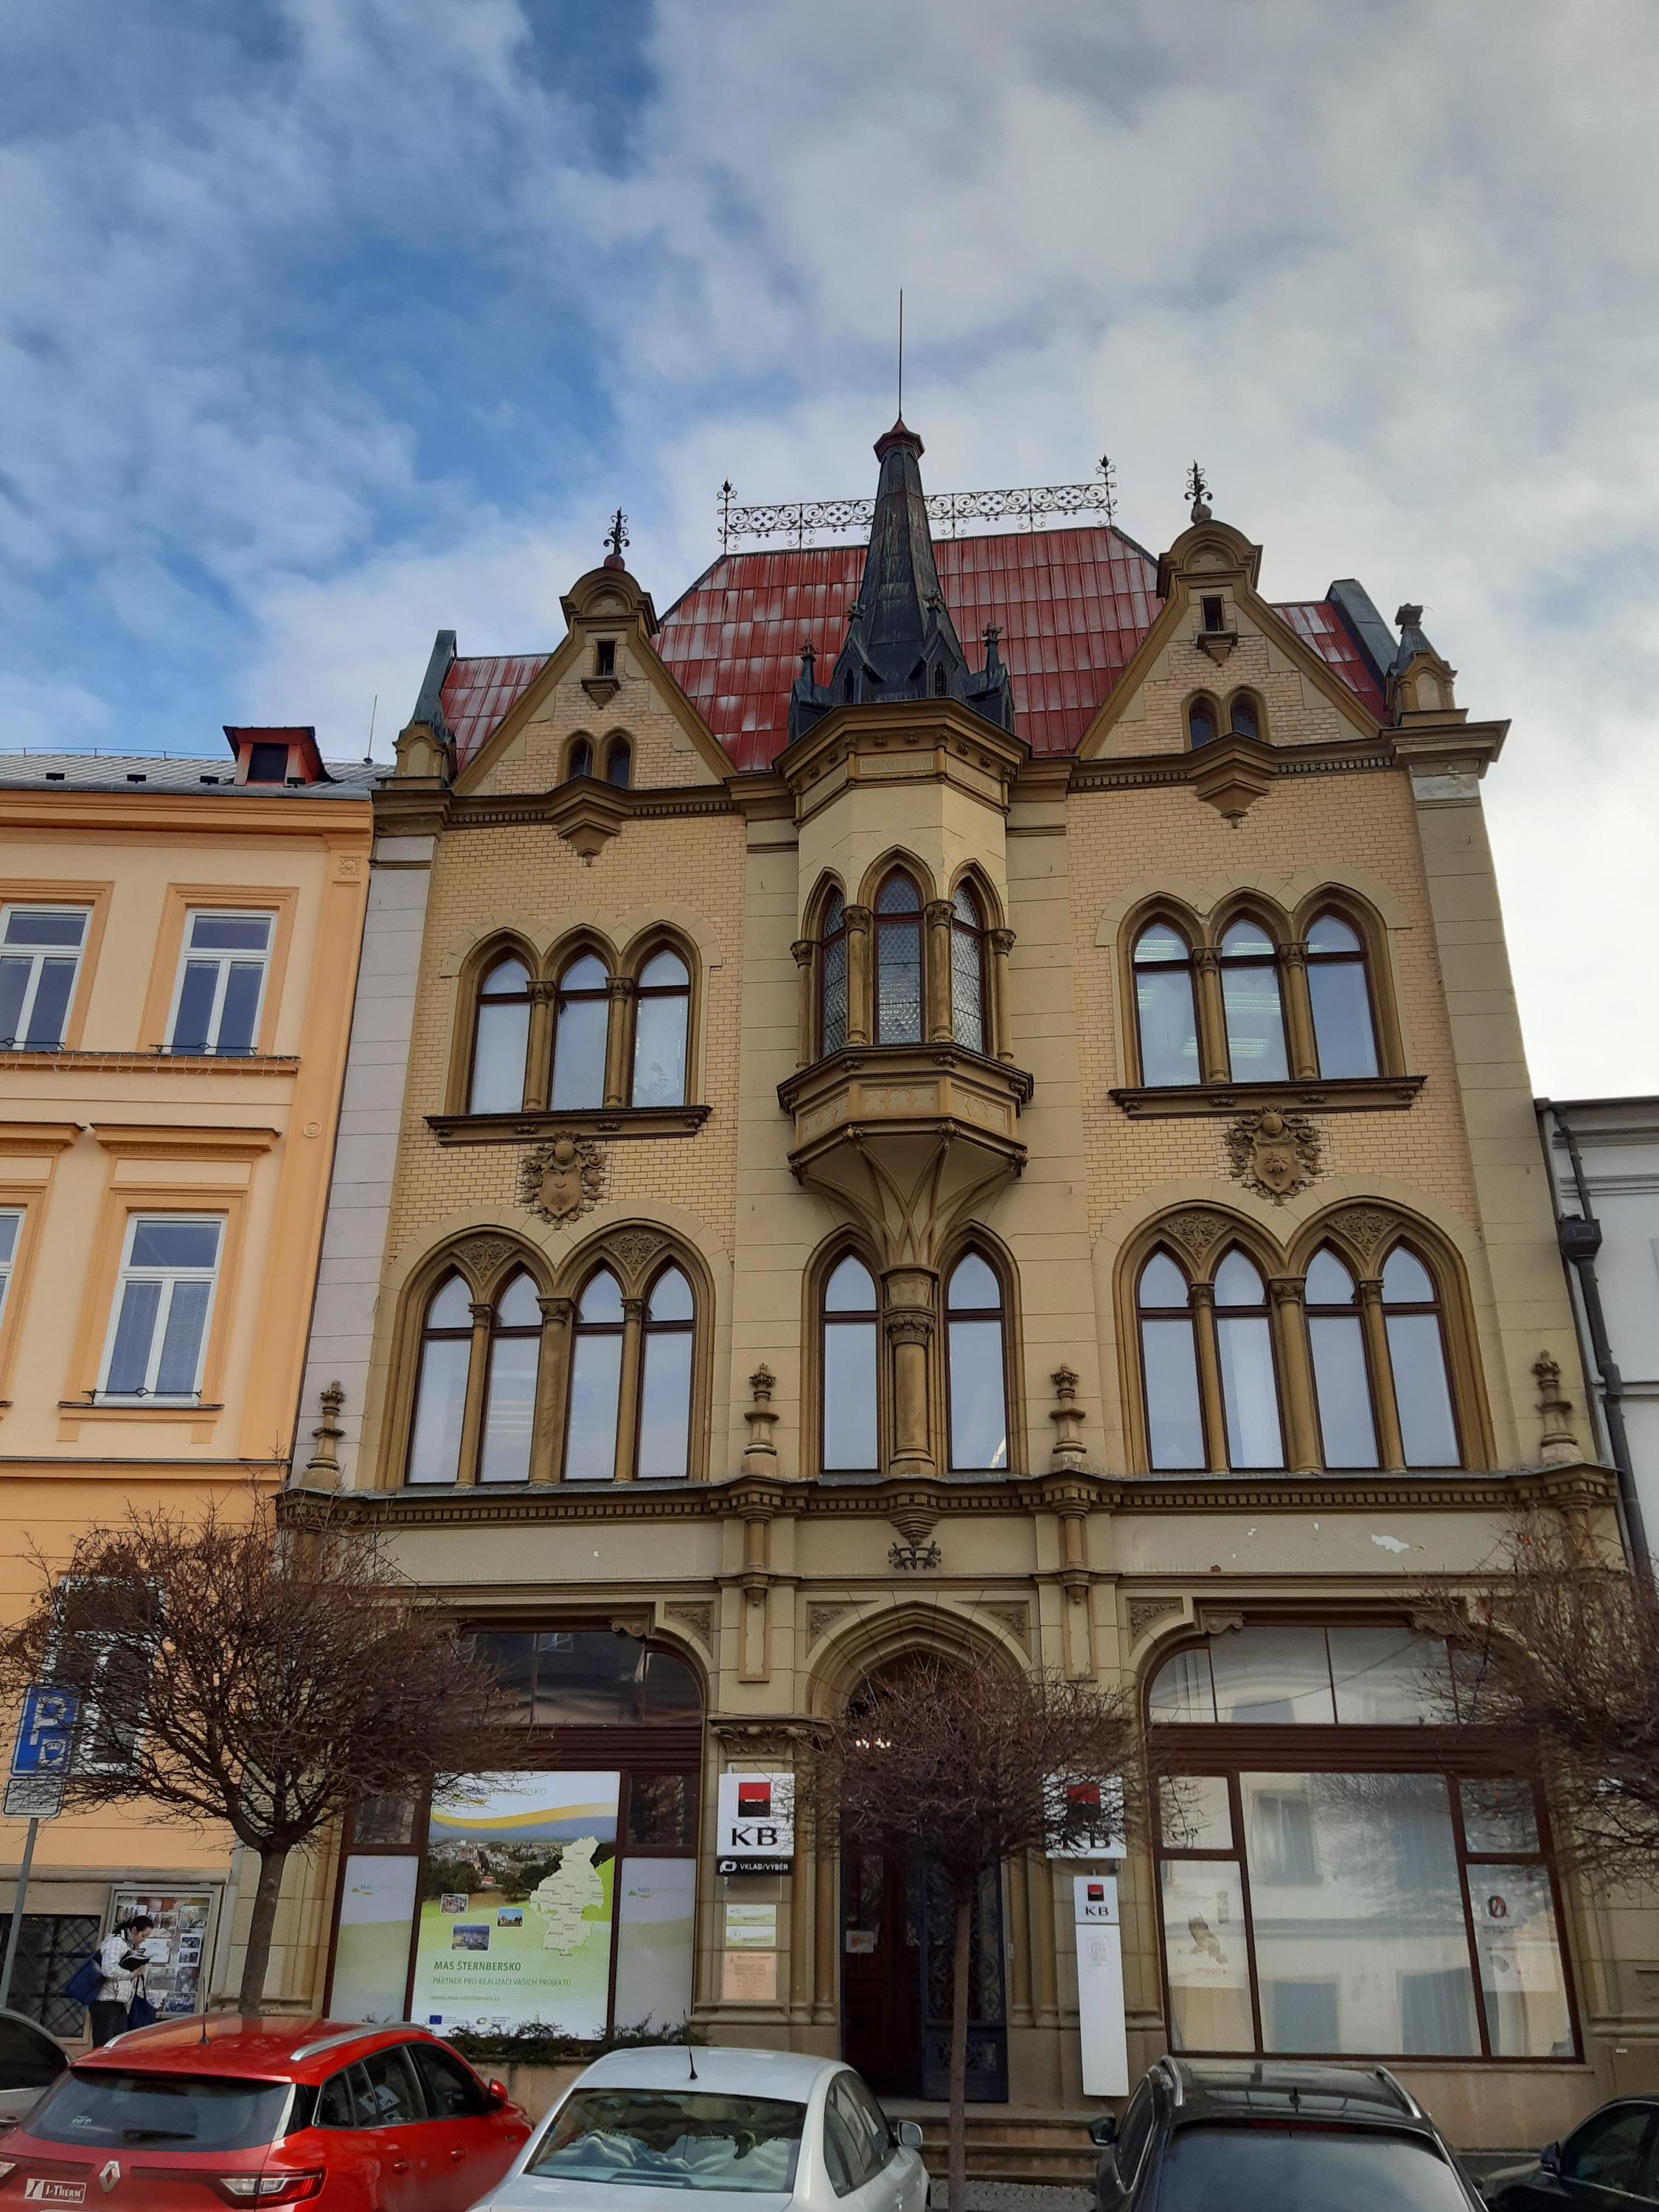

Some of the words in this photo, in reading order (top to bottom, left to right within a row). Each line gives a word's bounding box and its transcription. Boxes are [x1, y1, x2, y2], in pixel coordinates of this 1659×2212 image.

[29, 1696, 67, 1745] P
[731, 1827, 778, 1846] KB
[1062, 1827, 1111, 1849] KB
[1085, 1906, 1109, 1916] KB
[434, 1961, 455, 1970] MAS
[456, 1959, 521, 1971] ŠTERNBERSKO
[513, 1977, 537, 1986] VAŠICH
